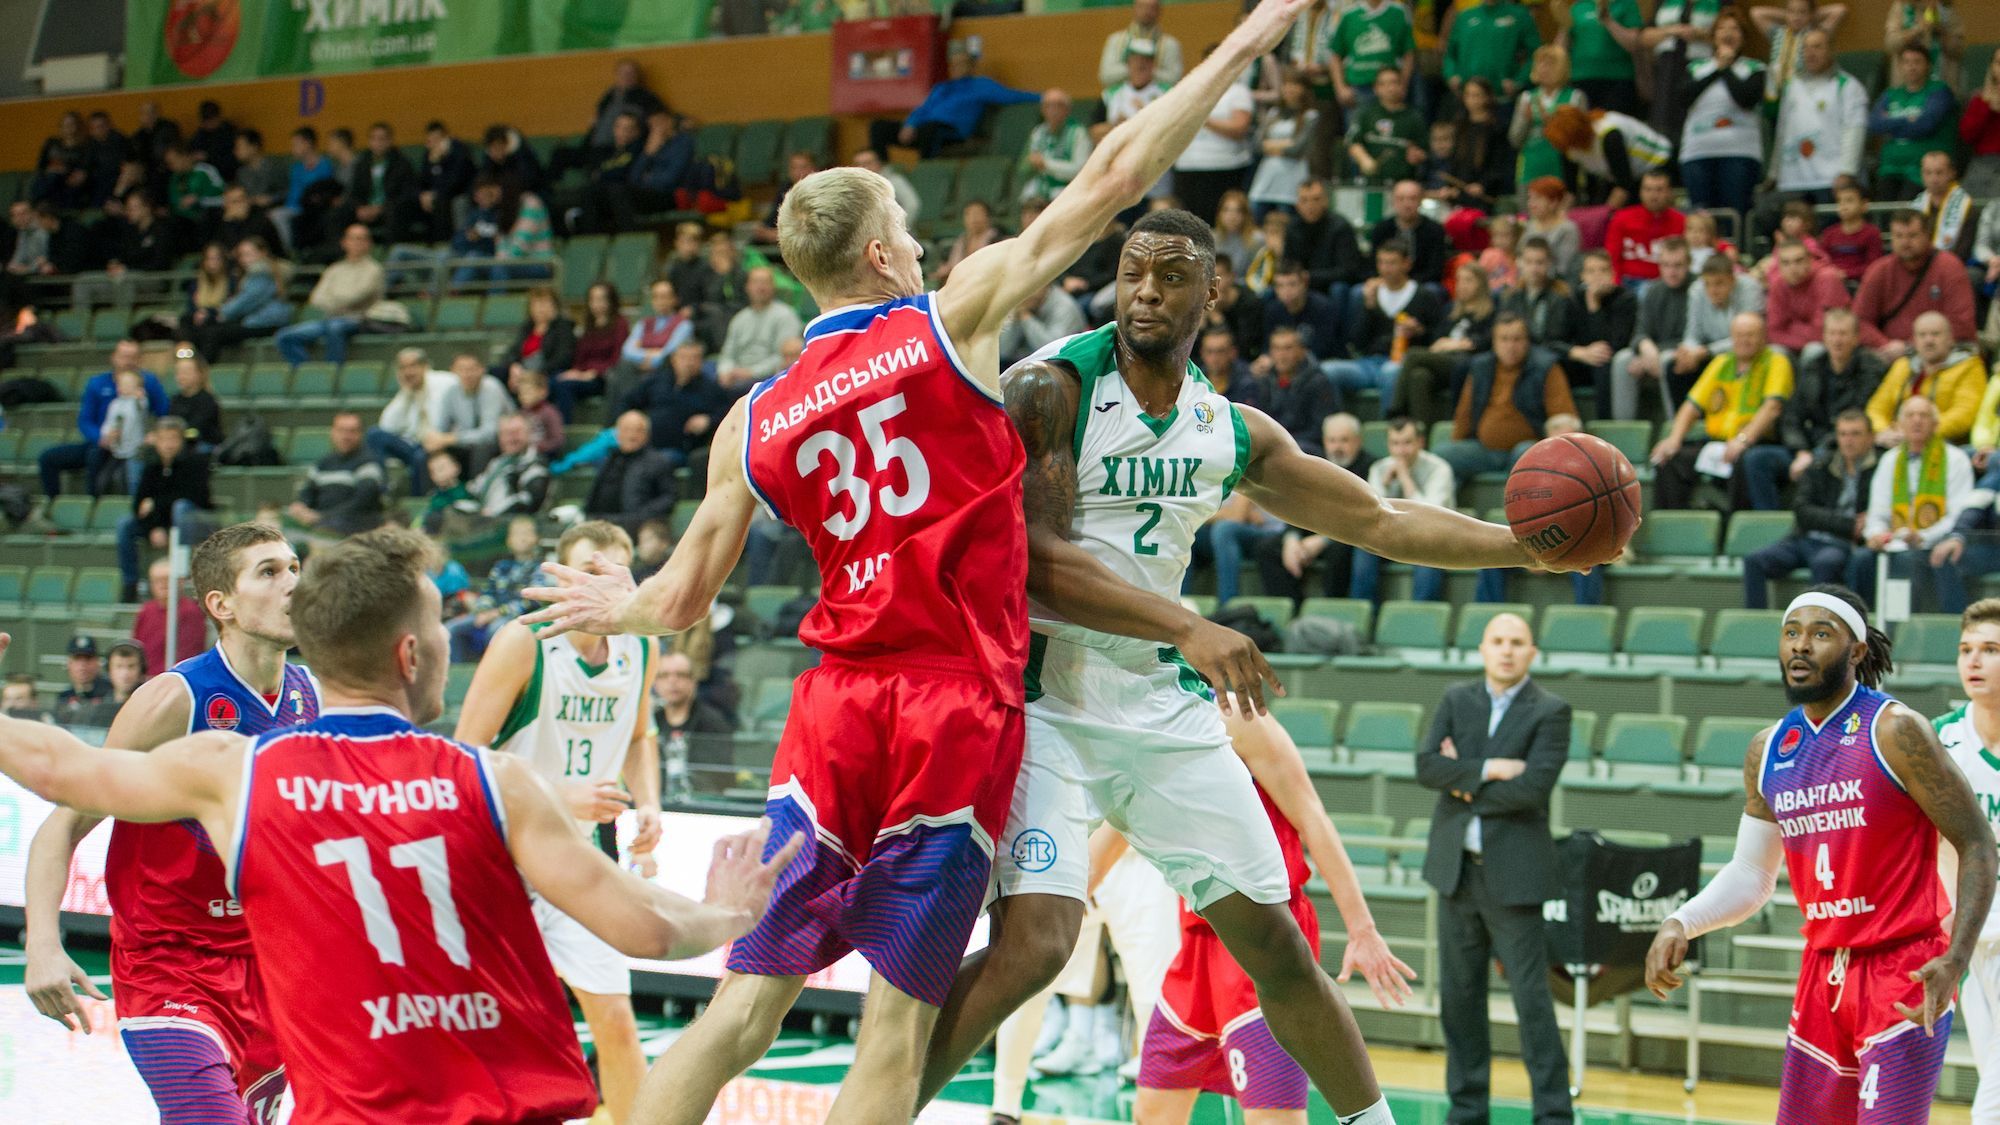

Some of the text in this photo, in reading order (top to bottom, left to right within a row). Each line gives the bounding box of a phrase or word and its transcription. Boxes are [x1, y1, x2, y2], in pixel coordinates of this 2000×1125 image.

[299, 79, 325, 117] D
[759, 337, 930, 443] ЗАВАДСЬКИЙ
[795, 392, 931, 541] 35
[1099, 456, 1203, 498] ХІМІК
[1134, 502, 1163, 556] 2
[555, 695, 619, 722] ХІМІК
[564, 739, 592, 776] 13
[276, 776, 459, 815] ЧУГУНОВ
[1774, 779, 1865, 813] АВАНТАЖ
[1815, 843, 1835, 891] 4
[312, 835, 472, 971] 11
[361, 991, 501, 1040] ХАРКІВ
[1229, 1048, 1249, 1092] 8
[1859, 1063, 1880, 1110] 4
